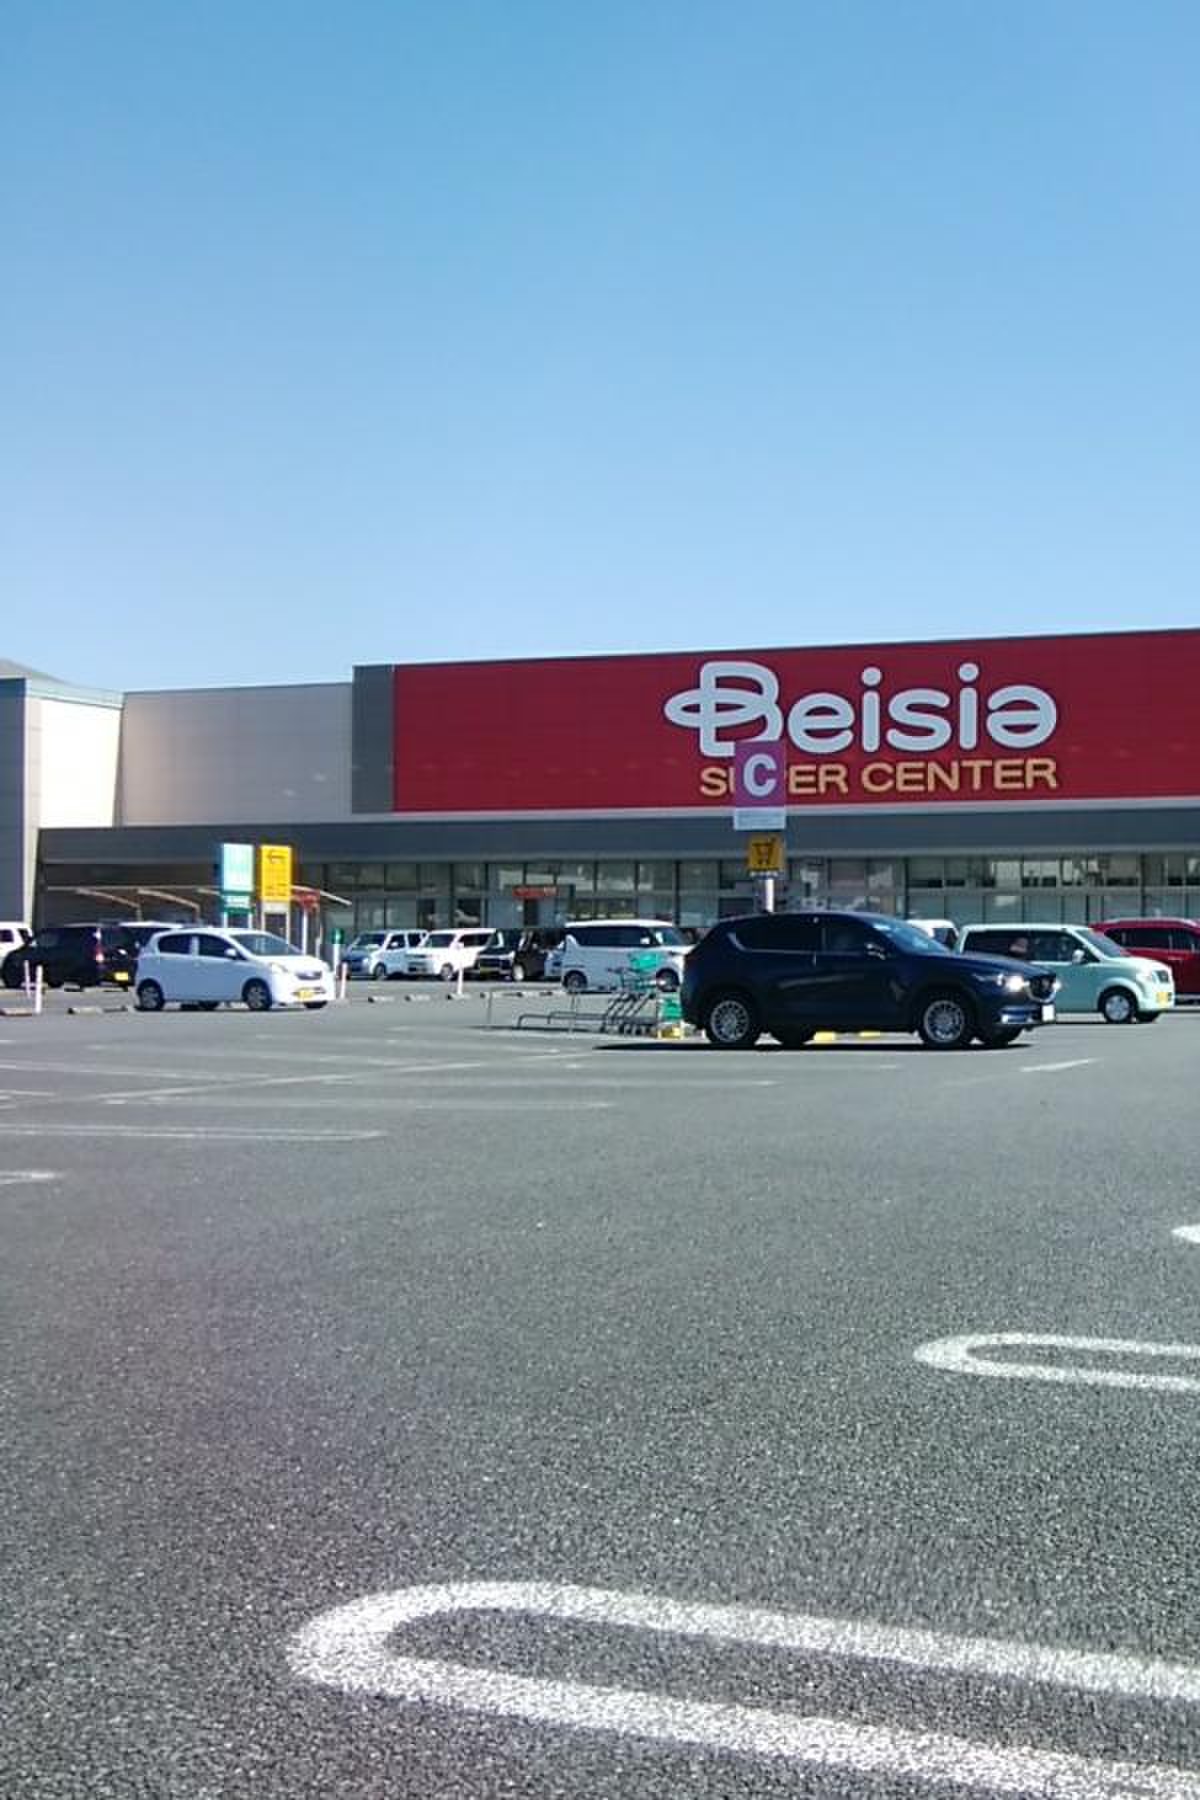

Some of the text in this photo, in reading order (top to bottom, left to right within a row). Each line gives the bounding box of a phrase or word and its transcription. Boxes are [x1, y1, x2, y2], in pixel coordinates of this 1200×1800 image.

[663, 660, 1058, 758] Beisia
[700, 758, 1058, 797] SER CENTER
[743, 753, 777, 797] C
